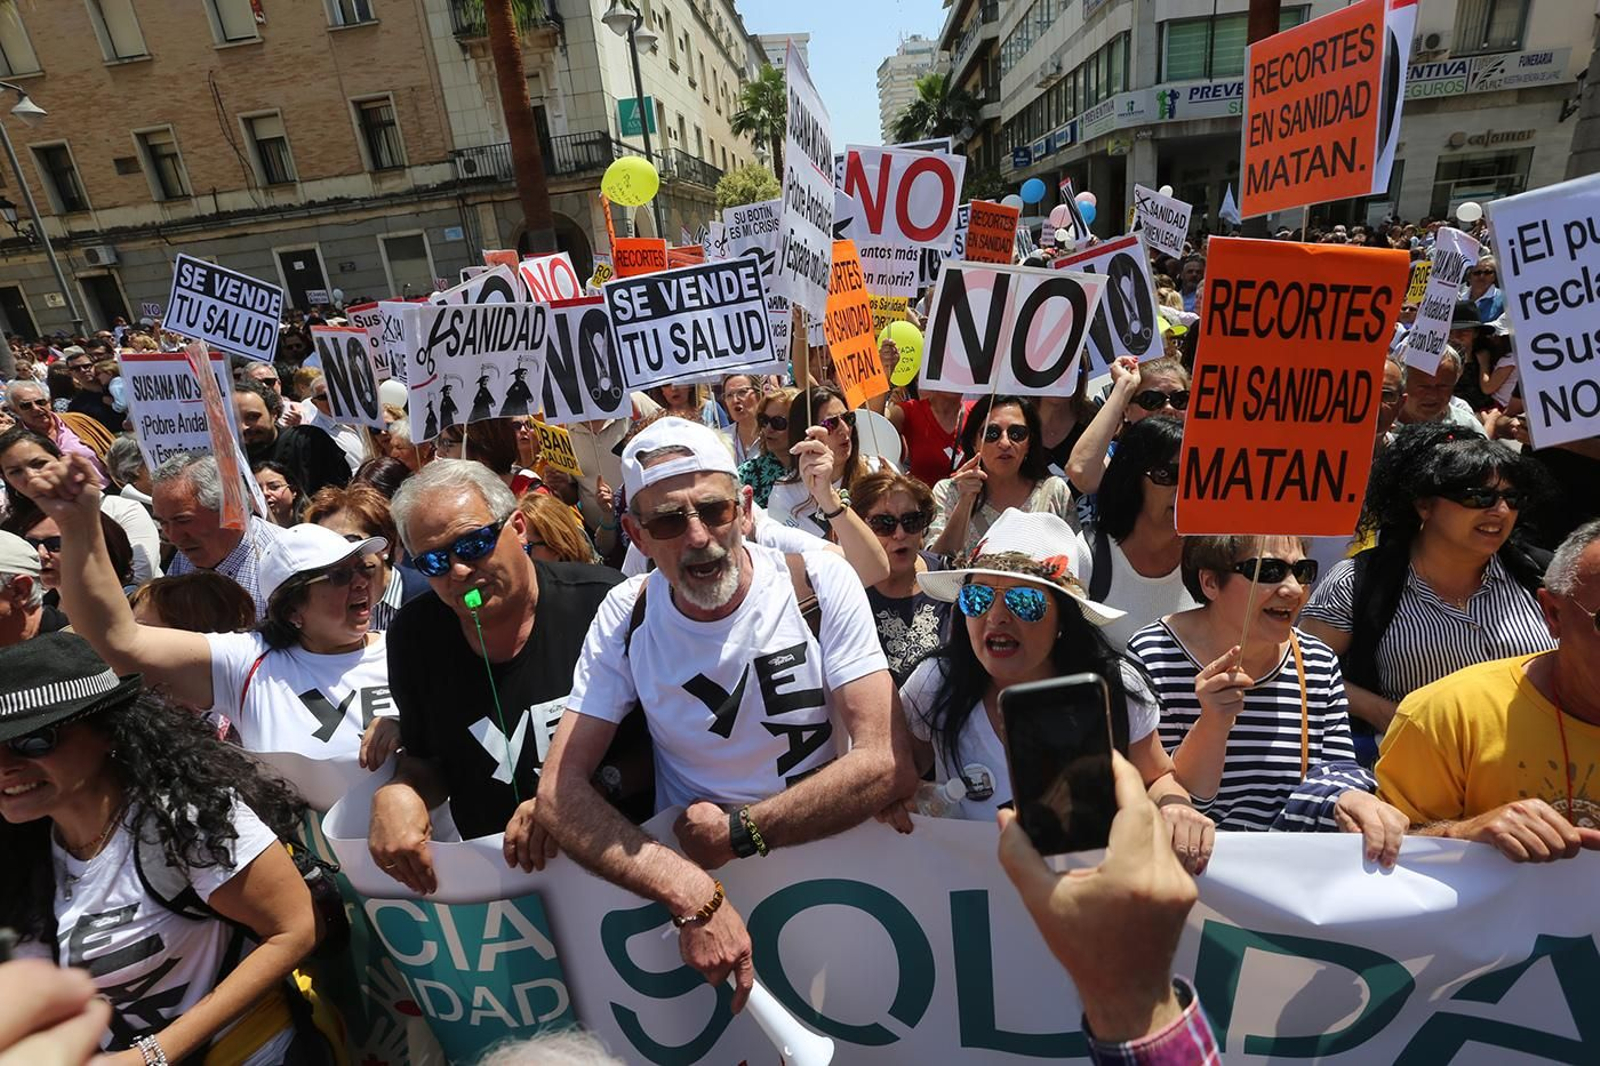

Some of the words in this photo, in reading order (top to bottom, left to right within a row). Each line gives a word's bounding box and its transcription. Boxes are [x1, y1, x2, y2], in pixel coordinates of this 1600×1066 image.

[1252, 23, 1376, 98] RECORTES
[1188, 81, 1244, 100] PREVE
[1249, 108, 1274, 148] EN
[1278, 80, 1372, 140] SANIDAD
[1246, 136, 1366, 196] MATAN.
[734, 212, 746, 225] SU
[844, 150, 956, 242] NO
[1150, 200, 1187, 231] SANIDAD,
[729, 226, 741, 239] ES
[742, 223, 752, 237] MI
[753, 218, 779, 235] CRISIS
[970, 209, 1016, 232] RECORTES
[979, 234, 1012, 254] SANIDAD
[616, 249, 666, 267] RECORTES
[860, 246, 892, 260] antos
[895, 246, 919, 261] más
[1508, 218, 1555, 277] ¡El
[1564, 216, 1600, 261] pu
[179, 263, 208, 291] SE
[214, 273, 282, 316] VENDE
[521, 257, 580, 304] NO
[612, 285, 652, 321] SE
[657, 266, 760, 312] VENDE
[829, 259, 863, 296] ORTES
[877, 271, 914, 287] morir?
[143, 302, 162, 316] NO
[176, 294, 203, 329] TU
[203, 304, 275, 351] SALUD
[353, 313, 381, 329] Sus
[446, 306, 546, 358] SANIDAD
[834, 303, 871, 342] SANIDAD
[926, 268, 1088, 388] NO
[1206, 278, 1393, 343] RECORTES
[543, 308, 624, 419] NO
[621, 328, 664, 375] TU
[670, 309, 766, 365] SALUD
[132, 374, 176, 401] SUSANA
[175, 373, 192, 400] NO
[316, 336, 379, 421] NO
[835, 347, 881, 393] MATAN.
[1194, 364, 1239, 421] EN
[1243, 365, 1373, 424] SANIDAD
[1538, 379, 1600, 428] NO
[178, 411, 209, 434] Andal
[535, 424, 574, 457] BAN
[546, 451, 578, 469] ALUD!
[1183, 446, 1355, 503] MATAN.
[363, 897, 557, 972] CIA
